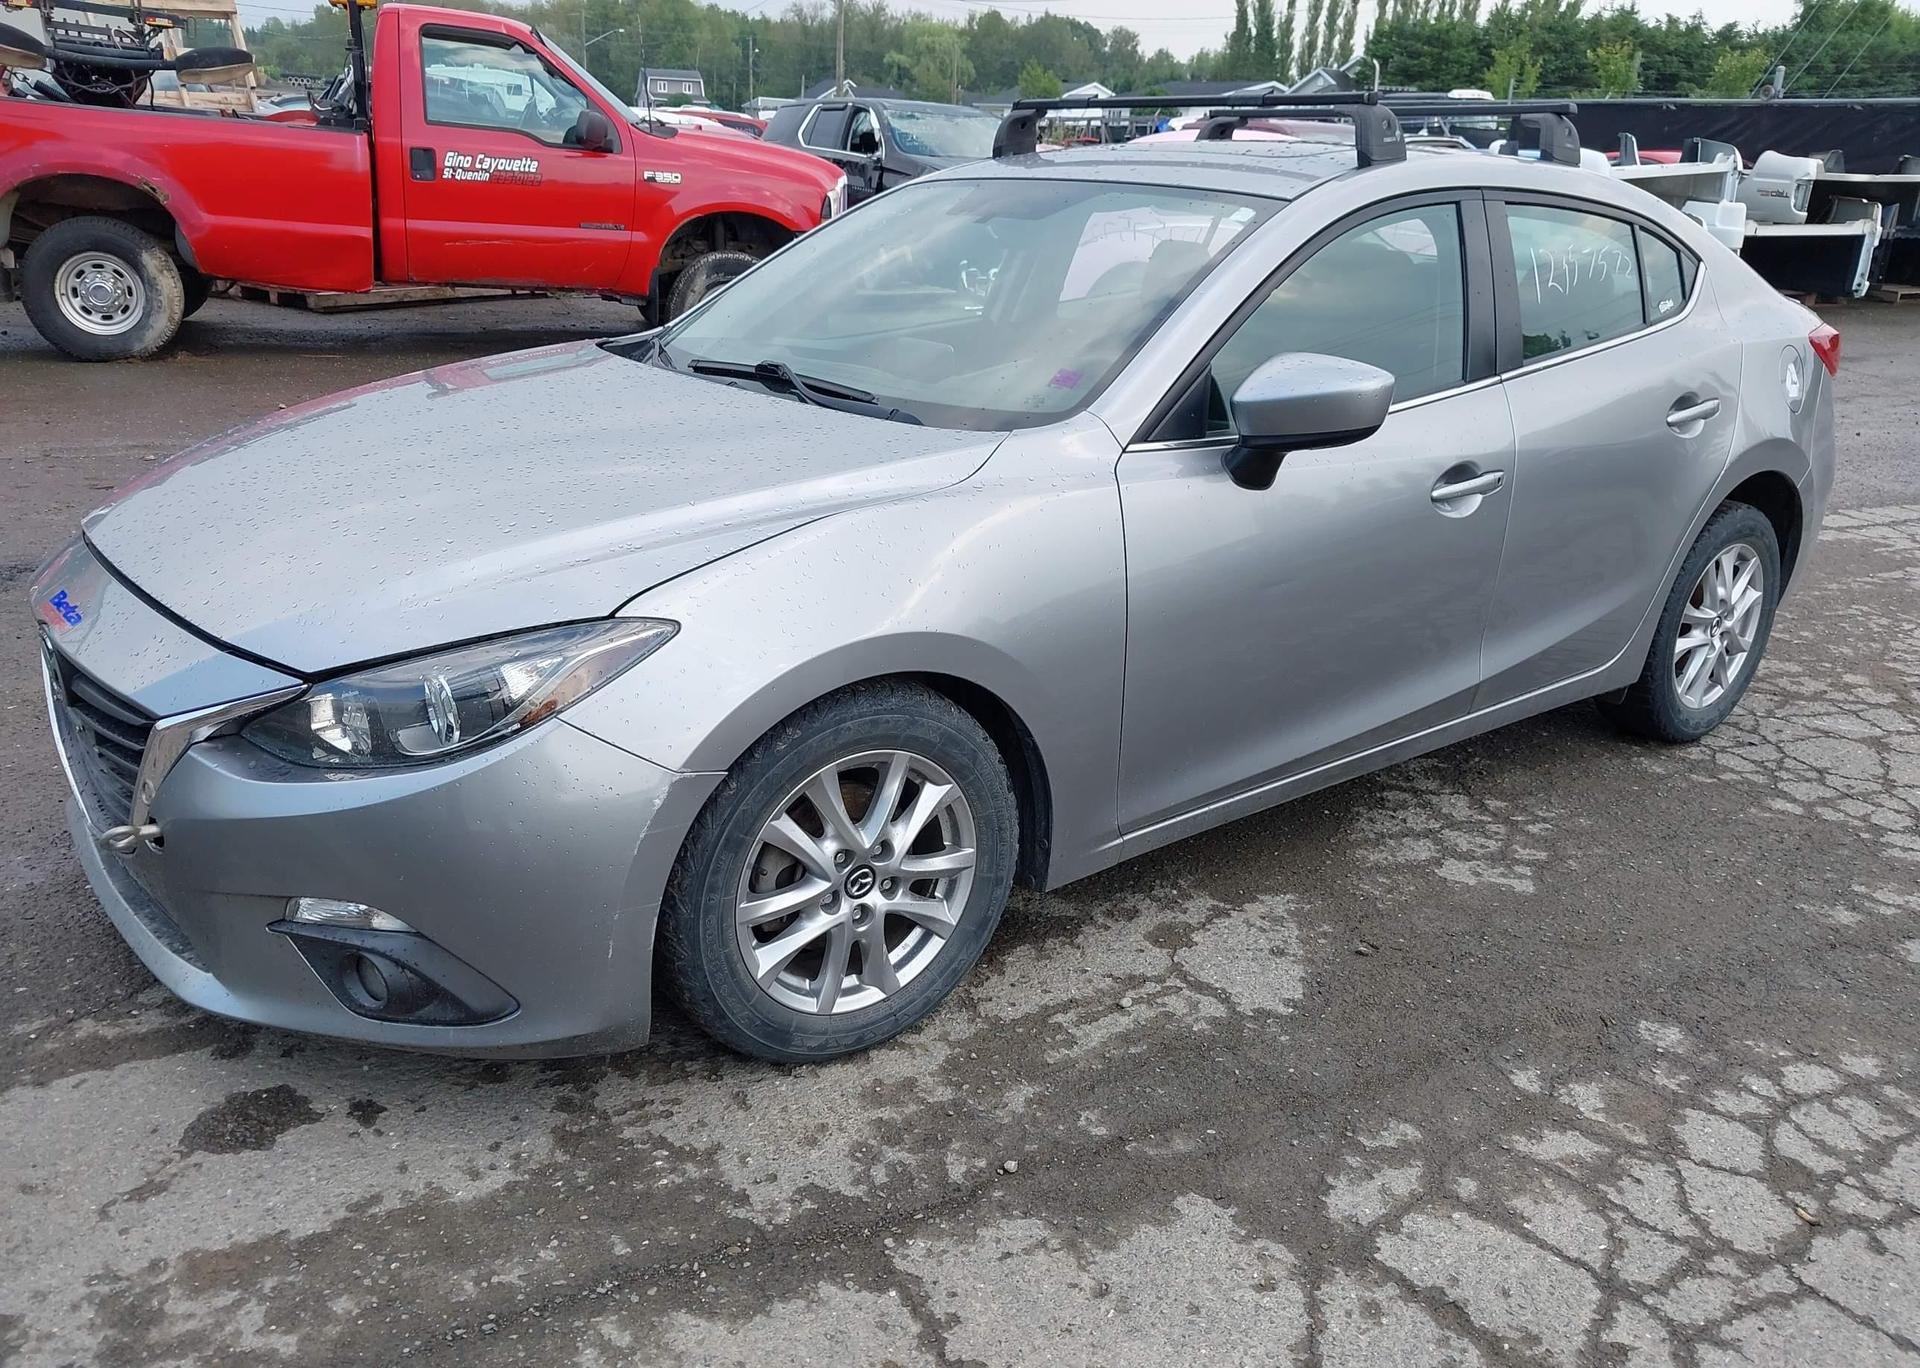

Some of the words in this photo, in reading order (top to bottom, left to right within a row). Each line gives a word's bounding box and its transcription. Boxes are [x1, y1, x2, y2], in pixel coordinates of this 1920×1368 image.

[444, 151, 472, 168] Gino
[475, 153, 538, 173] Cayouette
[442, 167, 490, 181] St-Quentin
